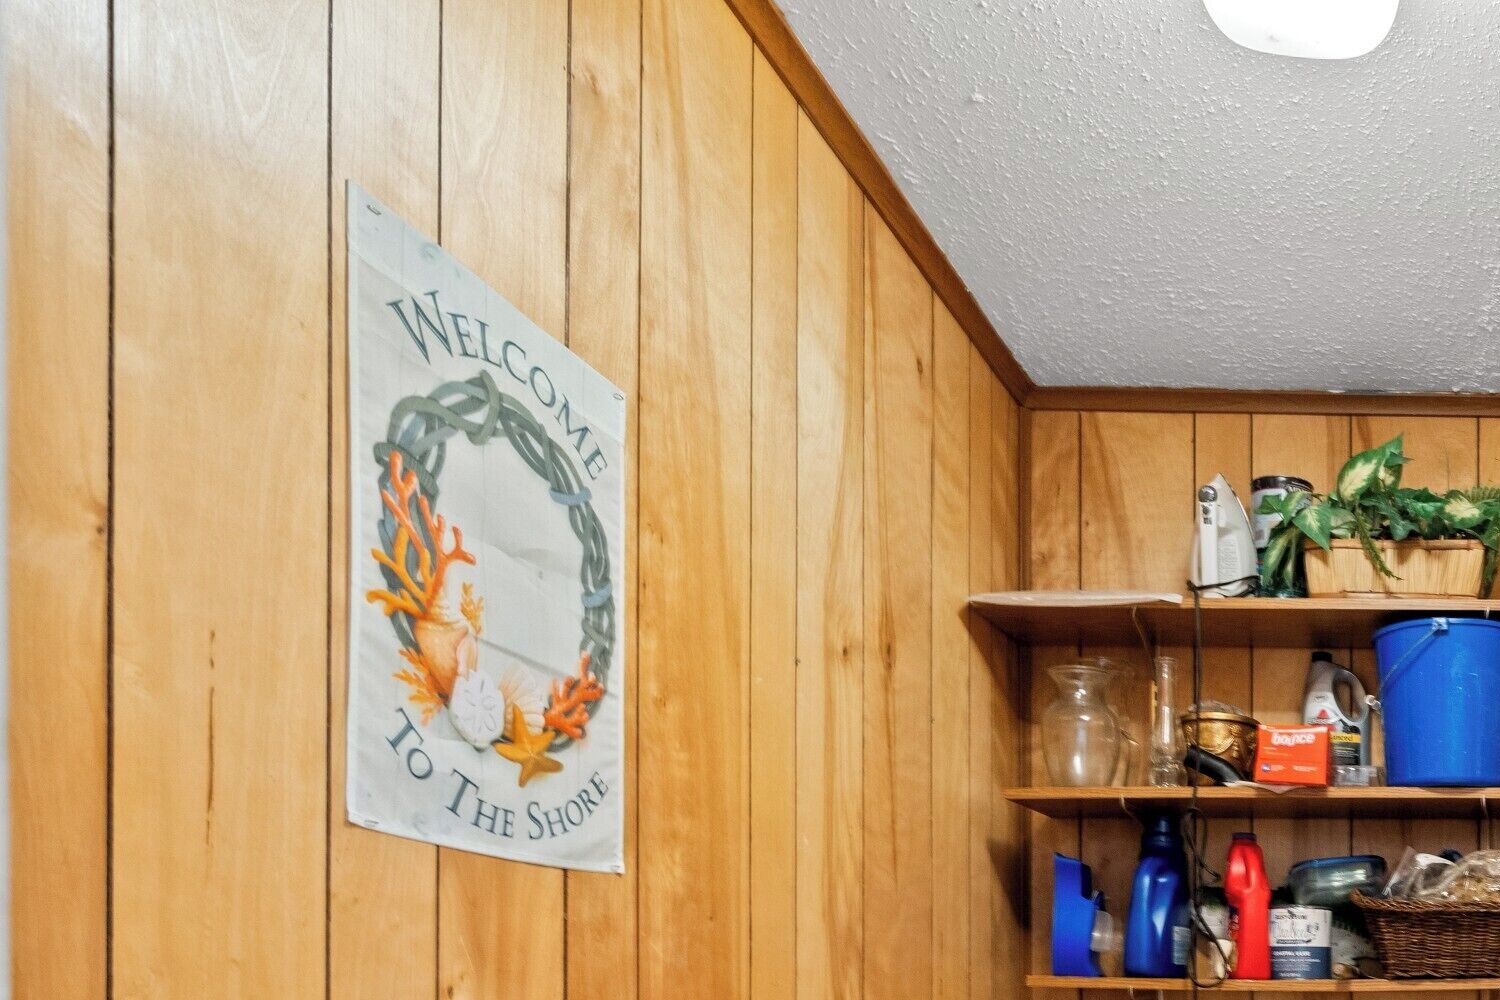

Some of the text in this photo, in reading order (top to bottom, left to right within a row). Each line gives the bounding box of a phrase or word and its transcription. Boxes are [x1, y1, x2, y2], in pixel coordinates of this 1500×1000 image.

[386, 290, 608, 481] WELCOME
[384, 707, 610, 840] TO THE SHORE
[1271, 732, 1316, 747] bounce
